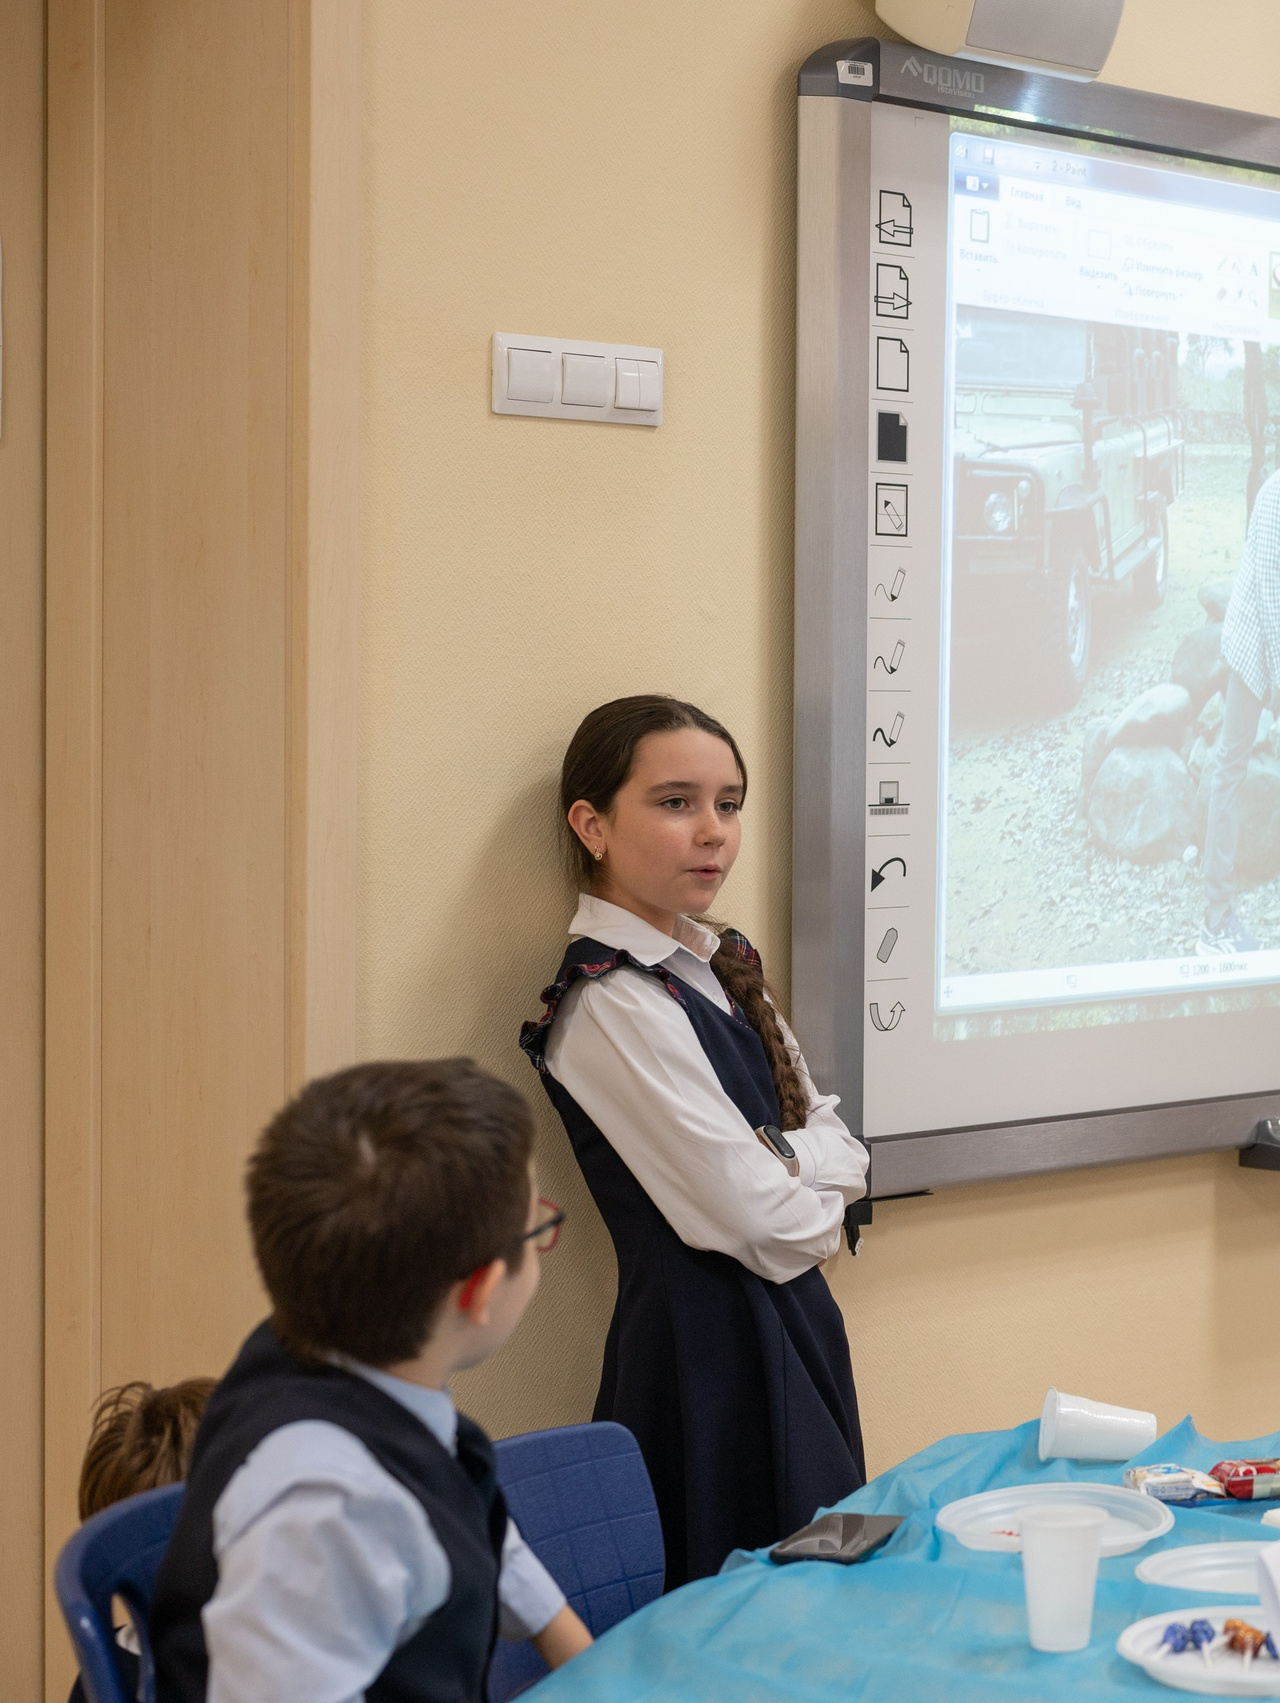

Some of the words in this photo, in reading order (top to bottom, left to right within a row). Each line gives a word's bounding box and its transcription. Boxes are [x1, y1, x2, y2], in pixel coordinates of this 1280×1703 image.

[923, 64, 985, 93] QOMO
[1051, 160, 1058, 173] 2
[1065, 163, 1087, 176] Paint
[1010, 187, 1044, 201] Главная
[1066, 196, 1082, 209] Вид
[960, 248, 998, 264] Вставить
[1079, 266, 1118, 282] Выделить
[1135, 261, 1174, 277] Изменить
[1175, 269, 1203, 281] размер
[1135, 286, 1177, 301] Повернуть
[1193, 964, 1210, 975] 1200
